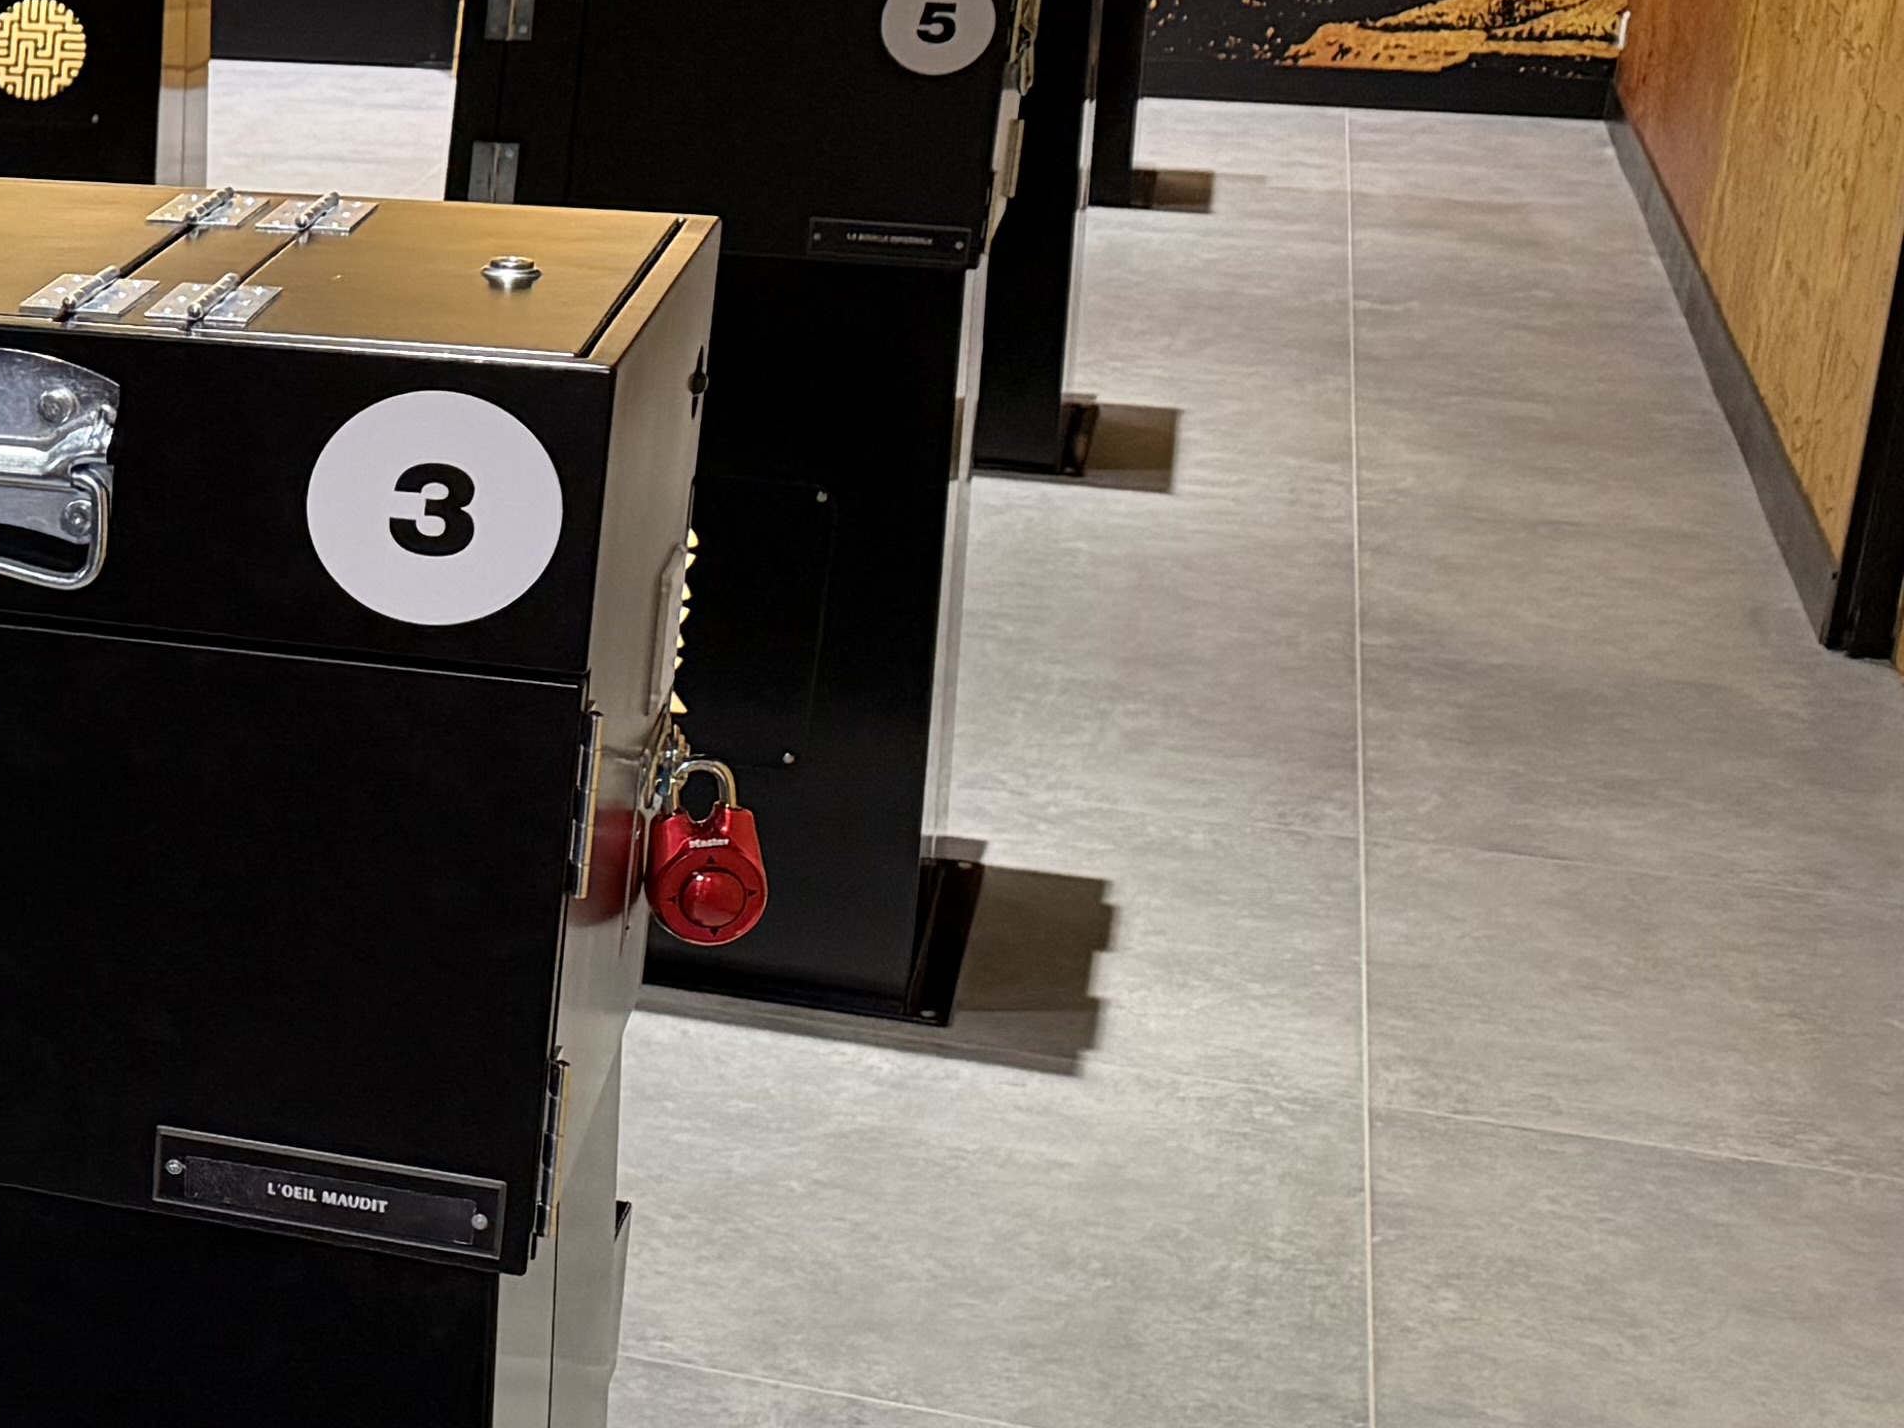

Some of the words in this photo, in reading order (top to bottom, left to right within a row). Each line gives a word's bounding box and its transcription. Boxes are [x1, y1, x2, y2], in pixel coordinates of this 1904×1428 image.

[916, 1, 957, 44] 5
[389, 462, 476, 557] 3
[267, 1182, 318, 1203] L'OEIL
[321, 1190, 389, 1214] MAUDIT
